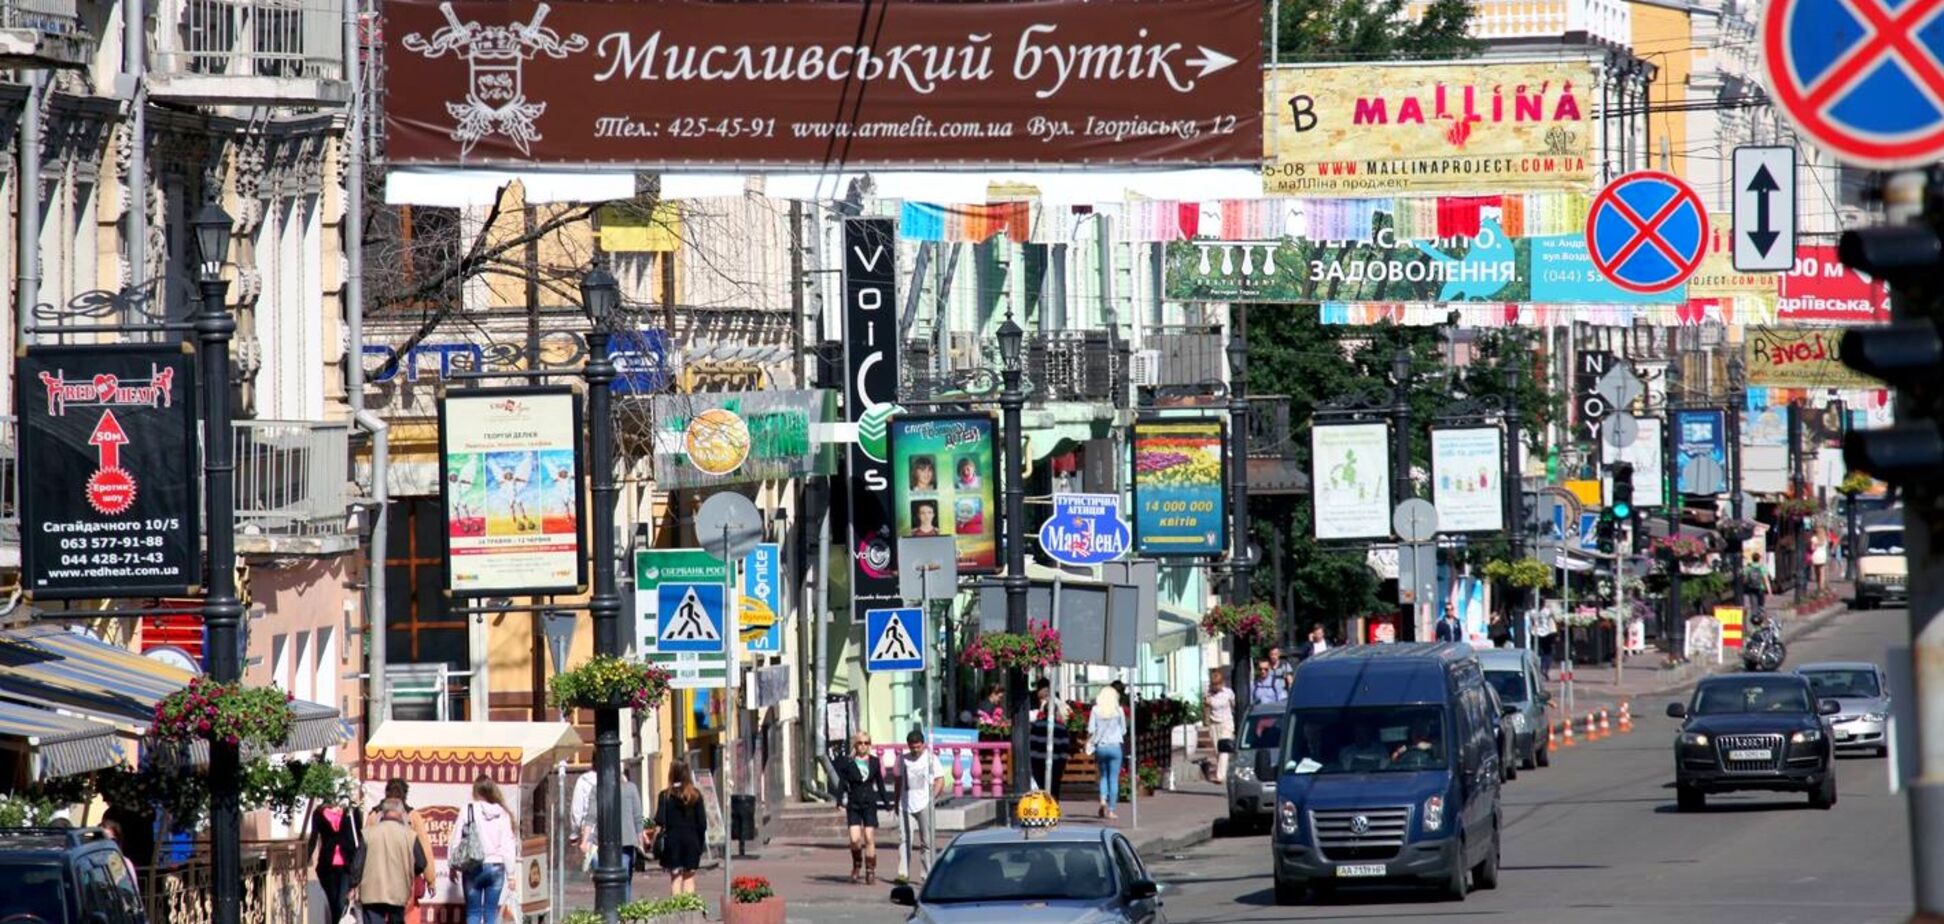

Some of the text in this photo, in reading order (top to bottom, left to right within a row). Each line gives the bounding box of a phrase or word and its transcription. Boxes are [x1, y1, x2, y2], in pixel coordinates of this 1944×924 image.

[593, 23, 1195, 99] Мисливський бутік
[593, 114, 1237, 142] Тел.: 425-45-91 www.armelit.com.ua Вул. Ігорівська, 12
[1317, 156, 1586, 177] WWW.MALLINAPROJECT.COM.UA
[1342, 175, 1409, 190] проджект
[1309, 259, 1523, 284] ЗАДОВОЛЕННЯ.
[1543, 269, 1582, 283] (044)
[65, 385, 96, 401] RED
[1144, 501, 1213, 512] 14 000 000
[43, 518, 180, 534] Сагайдачного 10/5
[60, 535, 164, 550] 063 577-91-88
[60, 552, 164, 566] 044 428-71-43
[48, 566, 180, 579] www.redheat.com.ua
